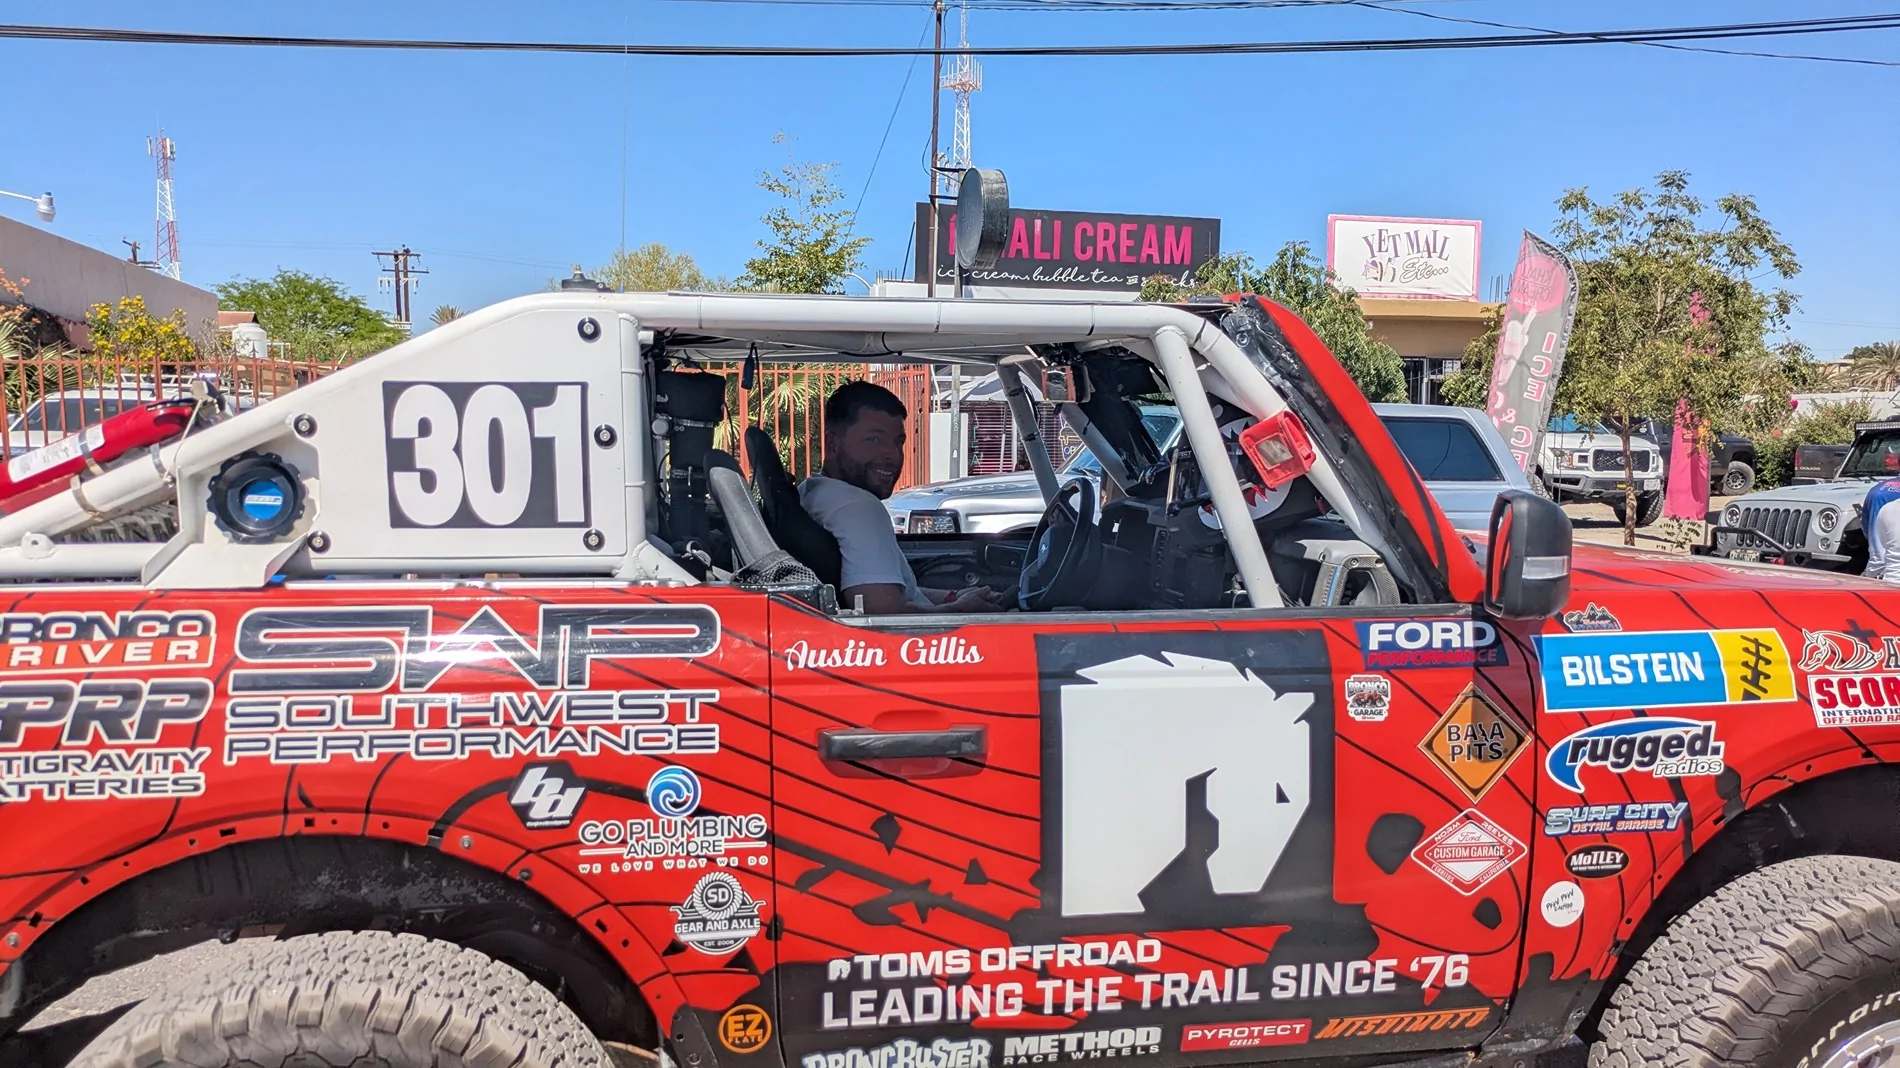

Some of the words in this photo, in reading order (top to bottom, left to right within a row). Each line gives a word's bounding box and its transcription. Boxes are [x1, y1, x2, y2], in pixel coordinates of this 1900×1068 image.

[948, 214, 1062, 261] ÍALI
[1074, 220, 1193, 266] CREAM
[1362, 229, 1401, 259] YET
[1404, 230, 1450, 261] MAIL
[1091, 268, 1124, 285] tea
[392, 383, 585, 526] 301
[0, 611, 215, 643] RONCO
[1368, 620, 1497, 650] FORD
[784, 638, 888, 671] Austin
[900, 636, 985, 666] Gillis
[1367, 649, 1498, 667] PERFORMANCE
[1561, 651, 1706, 687] BILSTEIN
[0, 677, 214, 747] PRP
[226, 690, 720, 731] SOUTHWEST
[1353, 708, 1384, 716] GARAGE
[1823, 715, 1883, 725] OFF-ROAD
[223, 724, 720, 764] PERFORMANCE
[1450, 741, 1503, 762] PITS
[1654, 758, 1723, 776] radios
[579, 820, 623, 844] GO
[628, 815, 768, 842] PLUMBING
[1545, 804, 1622, 835] SURF
[1624, 801, 1689, 830] CITY
[1571, 821, 1613, 834] DETAIL
[1616, 819, 1665, 831] GARAGE
[1434, 821, 1461, 842] NORM
[1481, 821, 1515, 846] REEVES
[1458, 831, 1482, 843] Ford
[625, 842, 665, 858] AND
[668, 839, 725, 856] MORE
[1433, 847, 1470, 859] CUSTOM
[1471, 845, 1505, 857] GARAGE
[579, 863, 602, 873] WE
[611, 861, 654, 873] LOVE
[664, 859, 707, 869] WHAT
[717, 857, 739, 867] WE
[749, 855, 769, 866] DO
[1431, 863, 1455, 883] CERRITOS
[1479, 859, 1510, 883] CALIFORNIA
[707, 888, 729, 904] SD
[674, 921, 704, 934] GEAR
[706, 919, 730, 932] AND
[731, 917, 761, 931] AXLE
[854, 949, 971, 981] TOMS
[980, 939, 1162, 973] OFFROAD
[822, 982, 1024, 1030] LEADING
[1035, 976, 1123, 1015] THE
[1135, 968, 1261, 1011] TRAIL
[1271, 957, 1398, 1000] SINCE
[727, 1013, 763, 1037] EZ
[1187, 1023, 1306, 1042] PYROTECT
[1314, 1007, 1491, 1041] MISHIMOTO
[1003, 1027, 1162, 1057] METHOD
[1003, 1054, 1059, 1066] RACE
[1071, 1045, 1161, 1062] WHEELS
